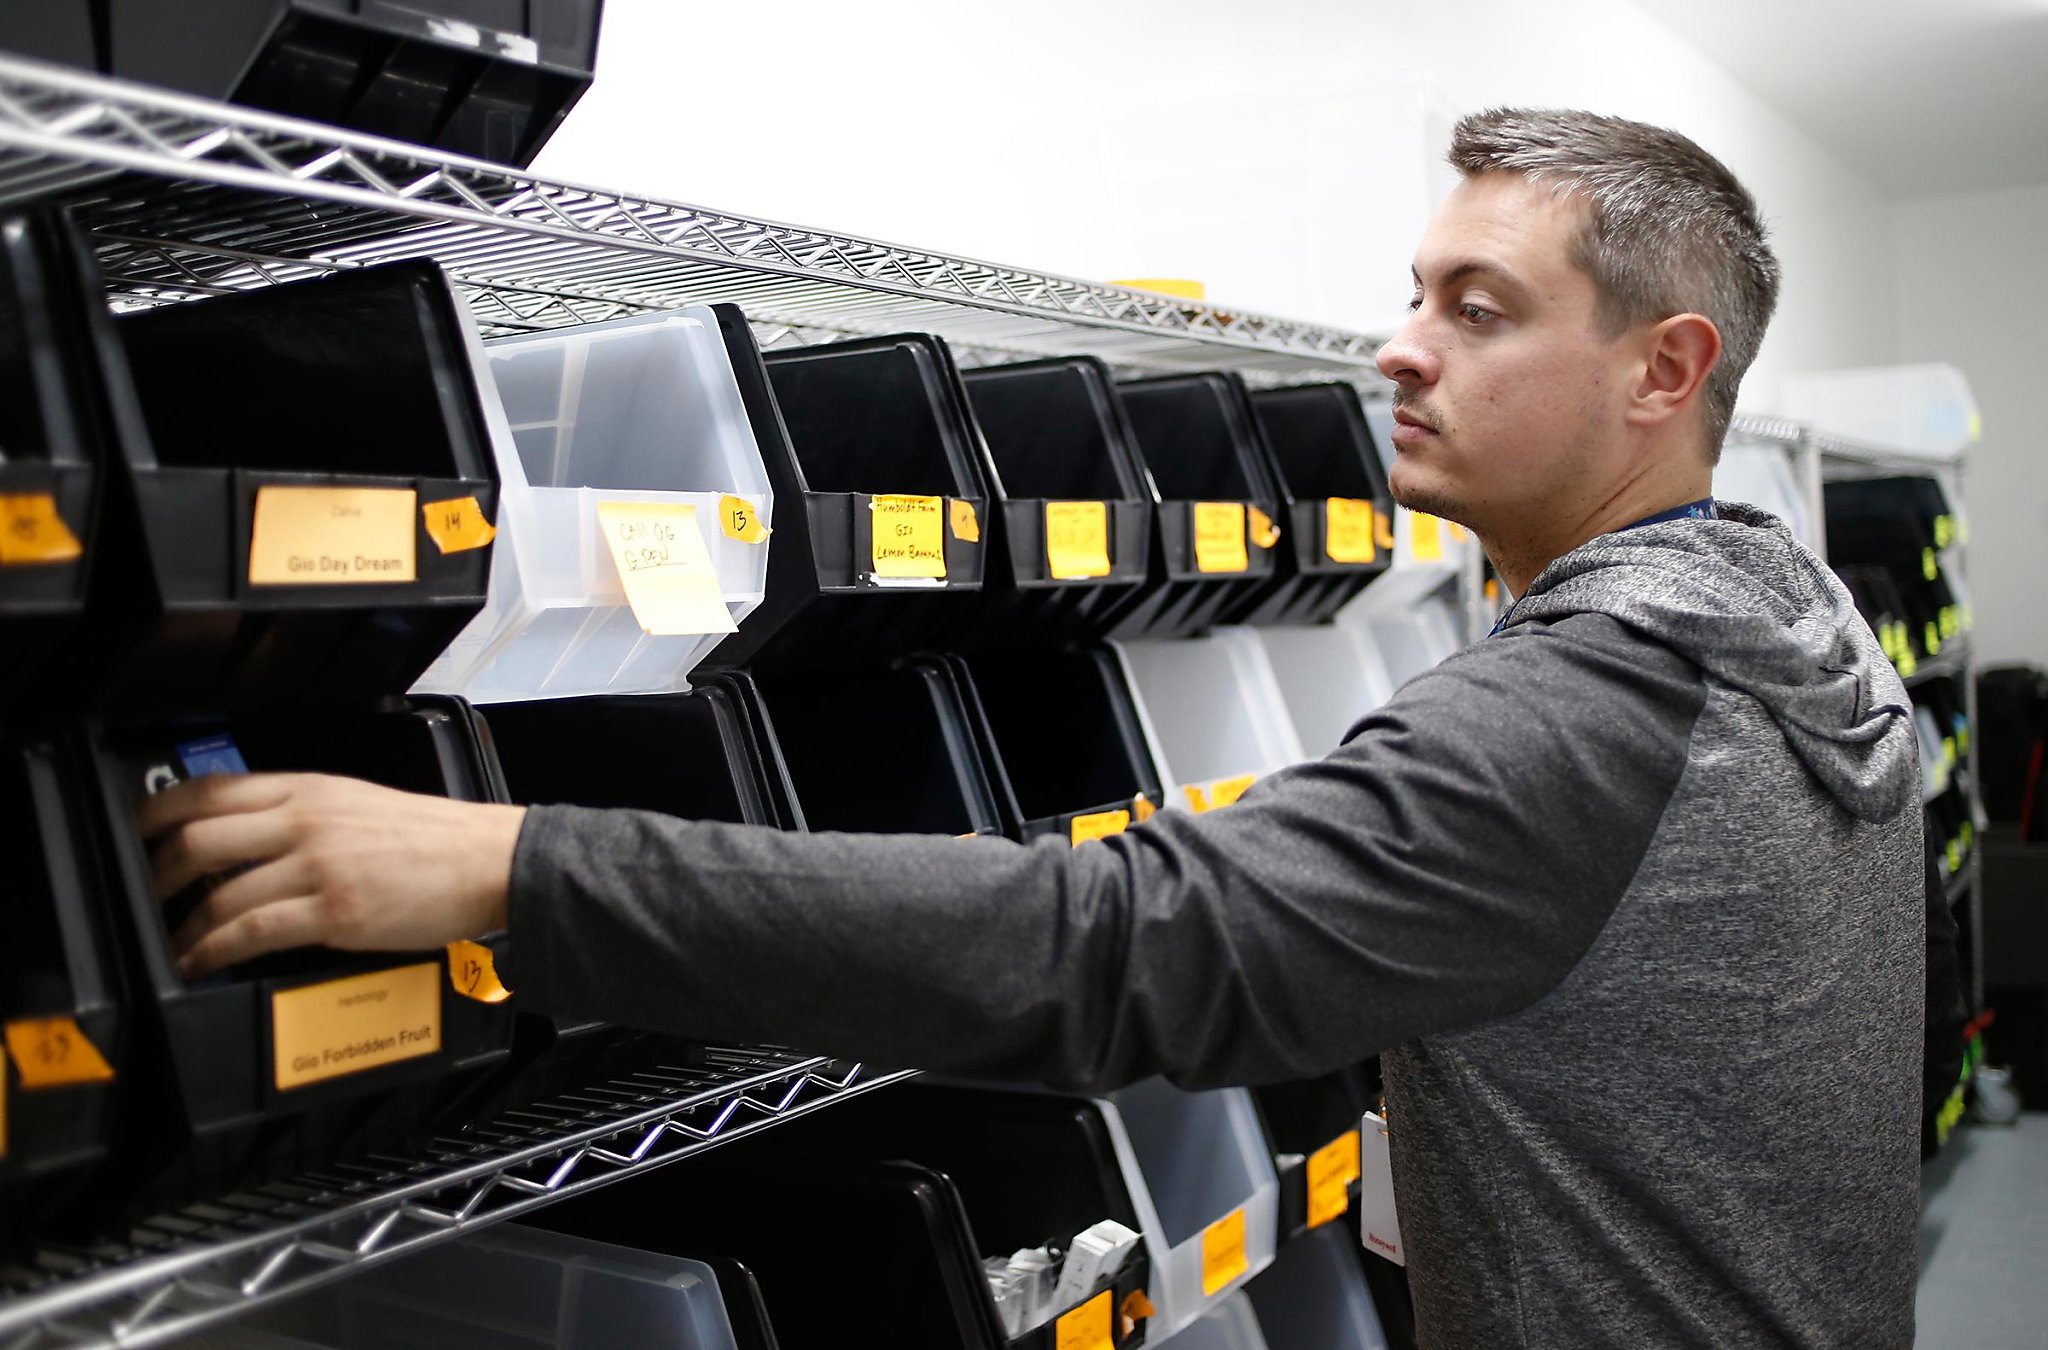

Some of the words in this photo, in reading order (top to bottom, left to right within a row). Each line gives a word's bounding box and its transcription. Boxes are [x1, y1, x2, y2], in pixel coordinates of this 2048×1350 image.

[732, 510, 747, 532] 13
[288, 557, 315, 572] Gio
[320, 557, 349, 574] Day
[355, 557, 403, 571] Dream
[463, 960, 482, 993] 13
[291, 1055, 319, 1073] Gio
[323, 1035, 396, 1063] Forbidden
[399, 1025, 432, 1048] Fruit
